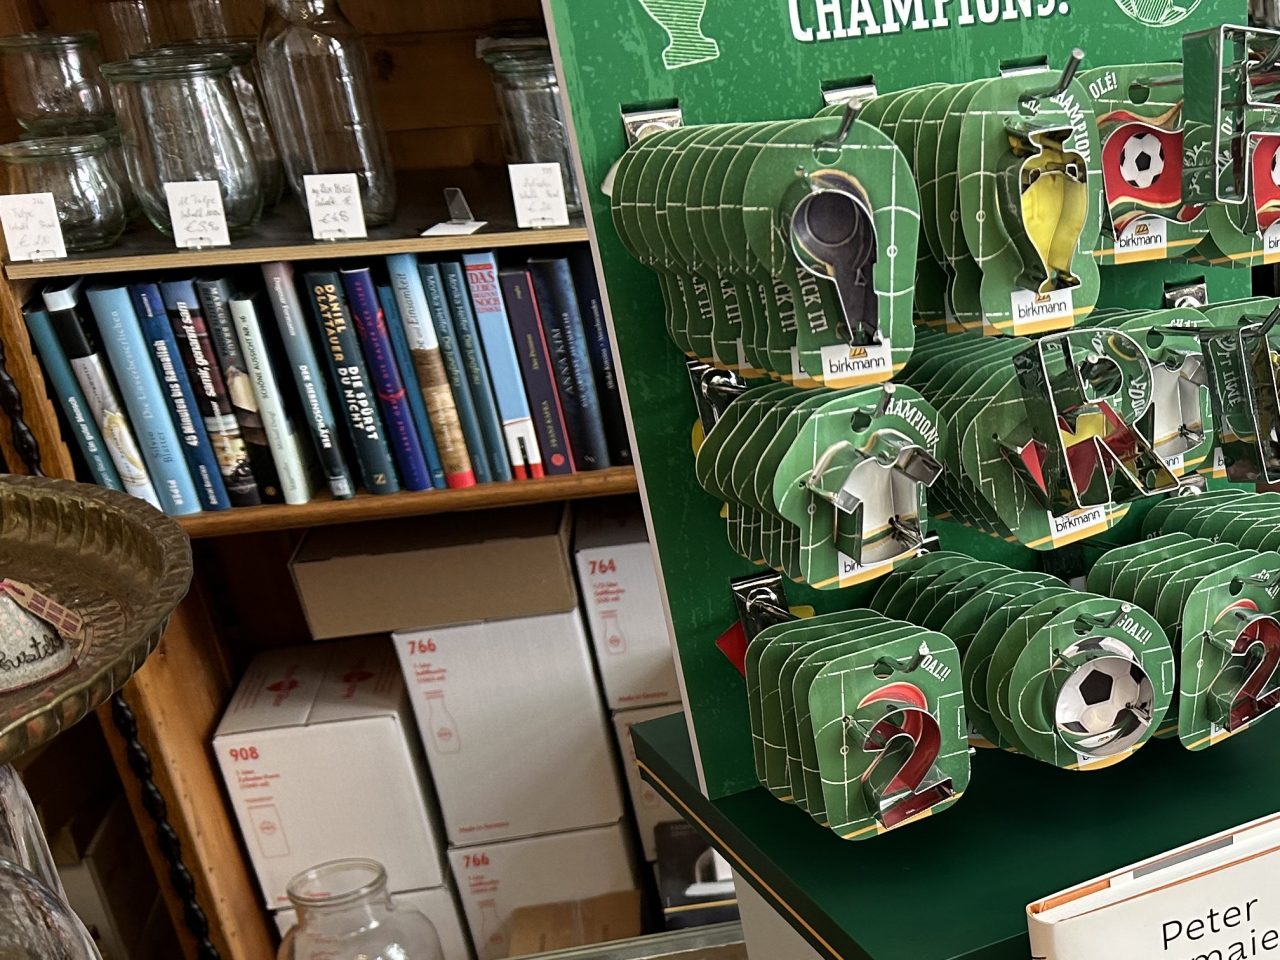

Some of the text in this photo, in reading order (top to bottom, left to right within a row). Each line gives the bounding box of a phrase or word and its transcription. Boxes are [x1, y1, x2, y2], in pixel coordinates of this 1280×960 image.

[1119, 234, 1162, 248] birkmann
[468, 270, 496, 285] DAS
[323, 282, 345, 333] DANIEL
[394, 271, 417, 326] Einsamkeit
[796, 266, 829, 334] KICK IT!
[1017, 300, 1068, 320] birkmann
[210, 285, 237, 357] MARCUS BRAUN
[314, 284, 344, 362] GLATTAUER
[298, 364, 310, 382] DER
[829, 355, 886, 375] birkmann
[153, 338, 199, 447] 45 Minuten bis Ramallah
[337, 366, 363, 430] DU NICHT
[347, 364, 379, 441] DIE SPÜRST
[167, 478, 183, 505] PIPER
[1054, 508, 1102, 534] birkmann
[588, 558, 617, 577] 764
[406, 638, 437, 655] 766
[920, 653, 953, 683] OAL!!
[229, 746, 260, 761] 908
[463, 851, 490, 869] 766
[1161, 898, 1259, 951] Peter
